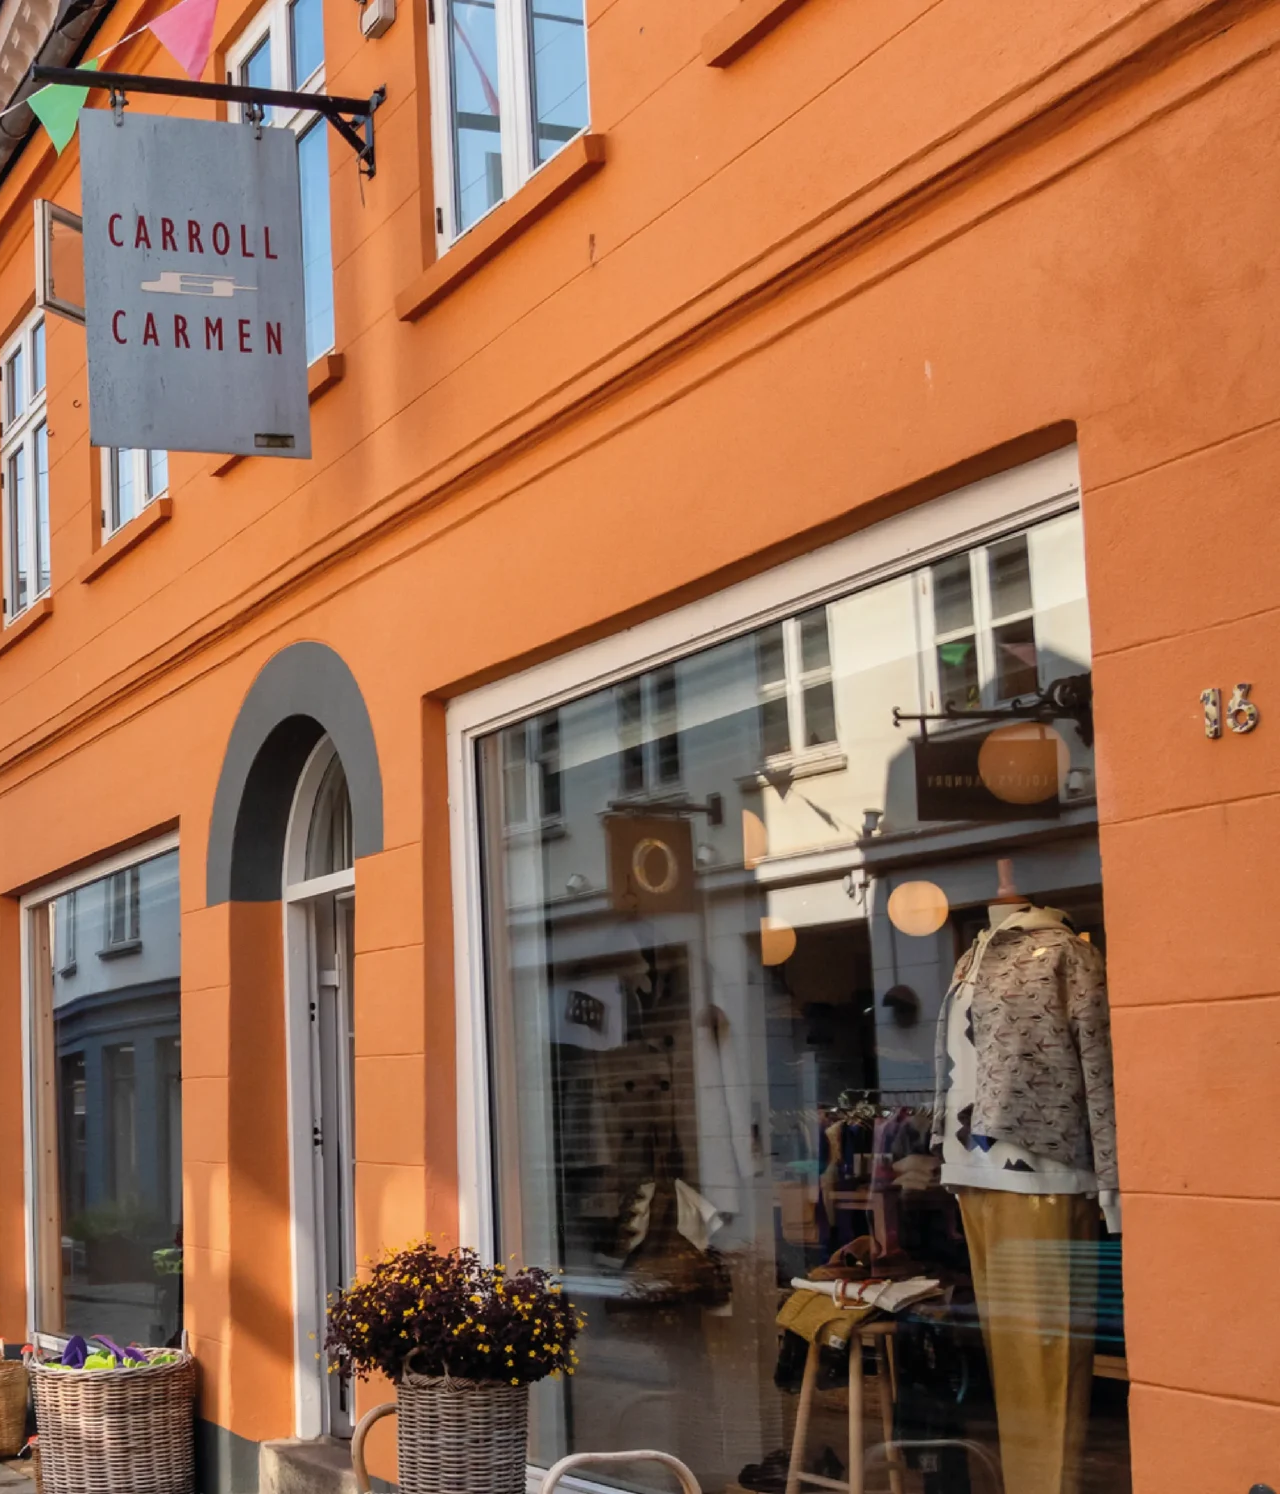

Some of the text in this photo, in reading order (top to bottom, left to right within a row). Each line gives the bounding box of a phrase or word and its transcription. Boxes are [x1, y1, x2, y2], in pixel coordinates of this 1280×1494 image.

[107, 212, 278, 261] CARROLL
[111, 309, 283, 356] CARMEN
[1200, 683, 1260, 739] 16
